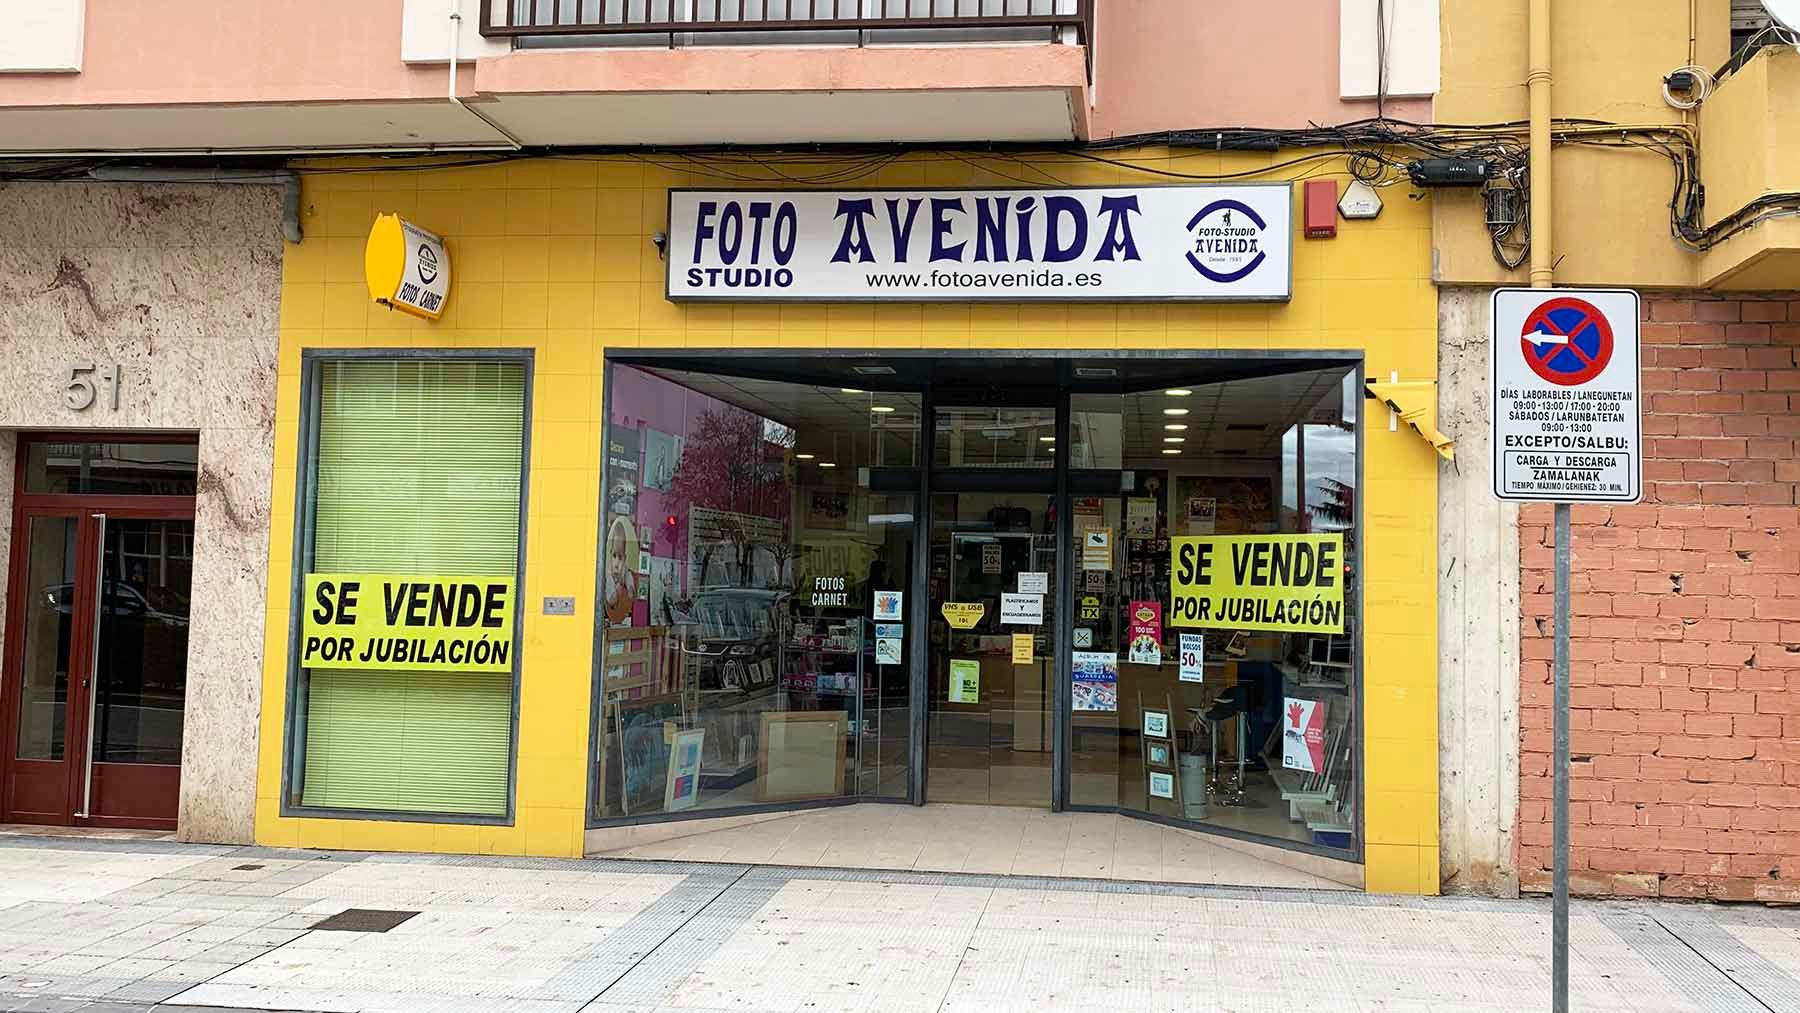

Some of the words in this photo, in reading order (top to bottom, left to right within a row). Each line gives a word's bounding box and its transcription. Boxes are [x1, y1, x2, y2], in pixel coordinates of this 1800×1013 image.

[693, 201, 797, 265] FOTO
[1199, 228, 1256, 236] FOTO-STUDIO
[687, 268, 793, 287] STUDIO
[866, 270, 1102, 287] www.fotoavenida.es
[399, 282, 420, 304] FOTOS
[420, 290, 442, 312] CARNET
[65, 361, 121, 411] 51
[1501, 388, 1518, 399] DÍAS
[1522, 390, 1572, 400] LABORABLES
[1578, 391, 1632, 401] LANEGUNETAN
[1556, 412, 1625, 422] LARUNBATETAN
[1516, 455, 1549, 466] CARGA
[1554, 456, 1560, 466] Y
[1566, 456, 1617, 467] DESCARGA
[1533, 470, 1600, 481] ZAMALANAK
[1511, 481, 1534, 489] TIEMPO
[1177, 543, 1213, 585] SE
[1232, 542, 1337, 587] VENDE
[815, 577, 845, 590] FOTOS
[312, 581, 360, 625] SE
[383, 583, 508, 628] VENDE
[812, 593, 847, 606] CARNET
[1082, 608, 1098, 618] TX
[1172, 596, 1210, 620] POR
[1215, 595, 1341, 625] JUBILACIÓN
[304, 637, 355, 661] POR
[360, 634, 509, 665] JUBILACIÓN
